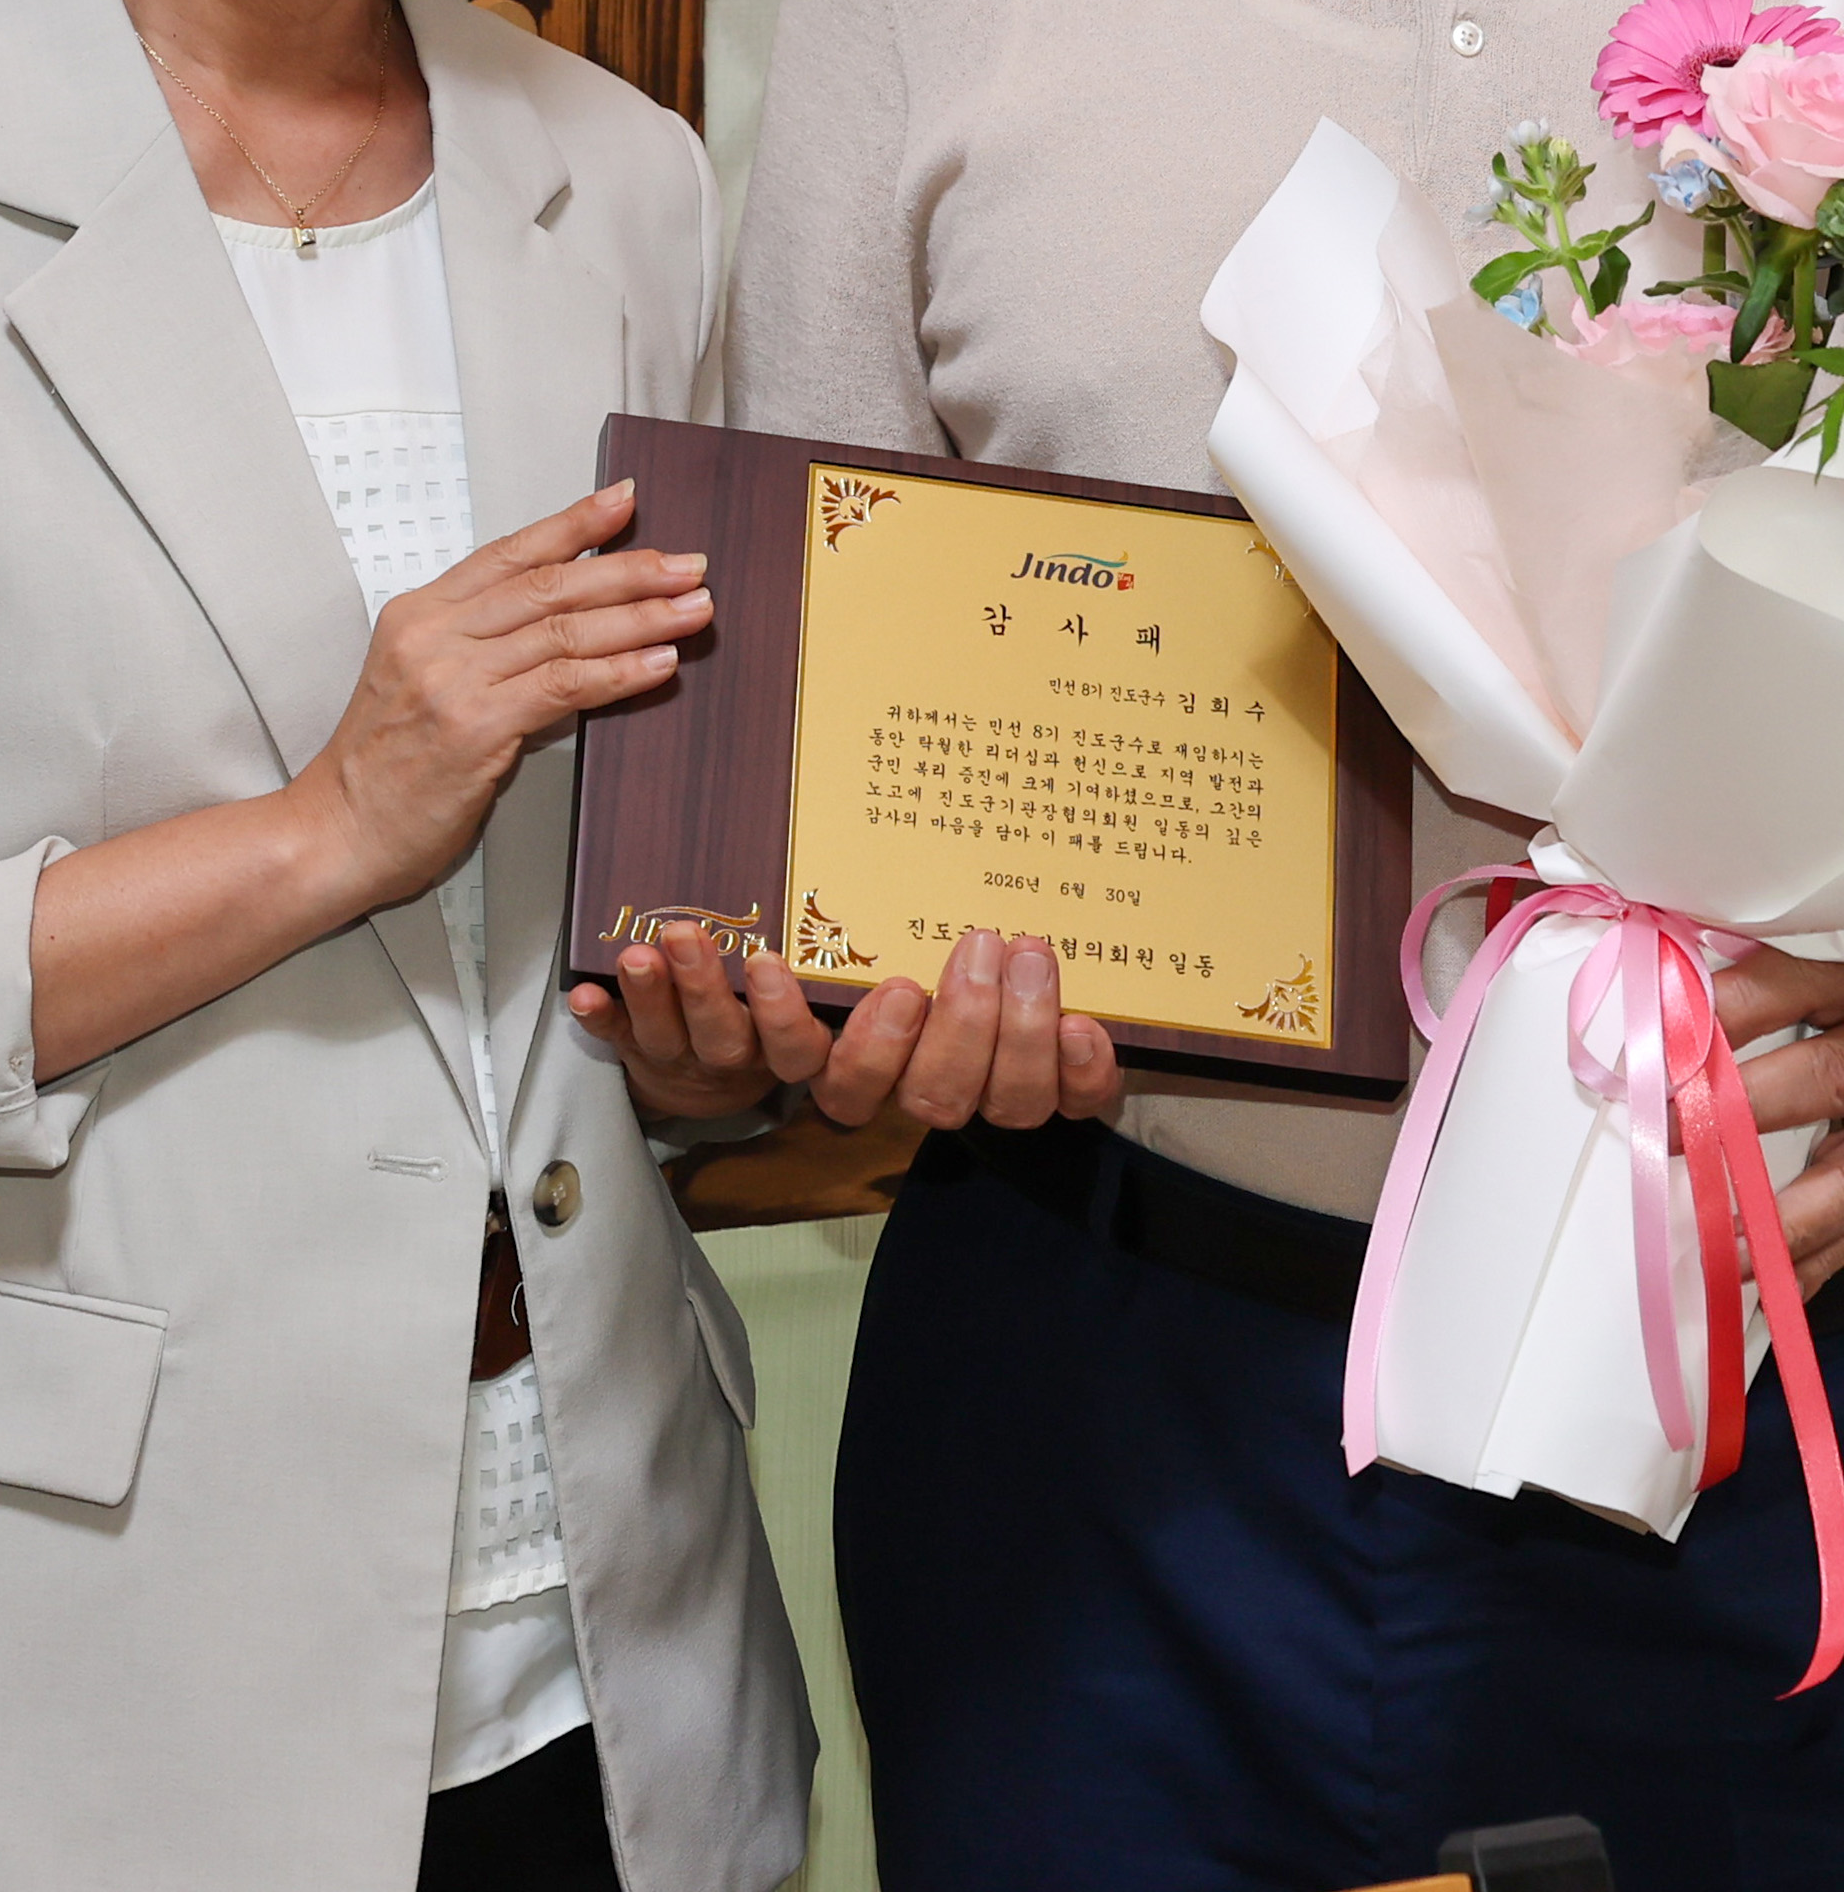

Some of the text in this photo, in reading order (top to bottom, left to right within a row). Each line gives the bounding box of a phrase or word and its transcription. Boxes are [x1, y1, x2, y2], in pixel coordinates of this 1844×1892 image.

[1011, 553, 1114, 588] Jindo
[1049, 678, 1076, 696] 민선
[1081, 683, 1102, 699] 8기
[1110, 685, 1166, 707] 진도군수
[869, 728, 905, 748] 동안
[986, 744, 1060, 768] 리더십과
[1074, 756, 1147, 779] 헌신으로
[1161, 766, 1194, 786] 지역
[1209, 773, 1264, 795] 발전과
[887, 705, 1264, 769] 귀하께서는 민선 8기 진도군수로 재임하시는
[866, 781, 922, 802] 노고에
[1154, 818, 1209, 841] 일동의
[1226, 828, 1263, 848] 깊은
[868, 755, 901, 774] 군민
[914, 761, 946, 779] 복리
[958, 767, 1009, 788] 증진에
[1022, 777, 1054, 794] 크게
[1209, 801, 1261, 821] 그간의
[865, 807, 1192, 865] 감사의 마음을 담아 이 패를 드립니다.
[984, 871, 1141, 906] 2026년 6월 30일
[907, 918, 1214, 978] 진도협의회원 일동
